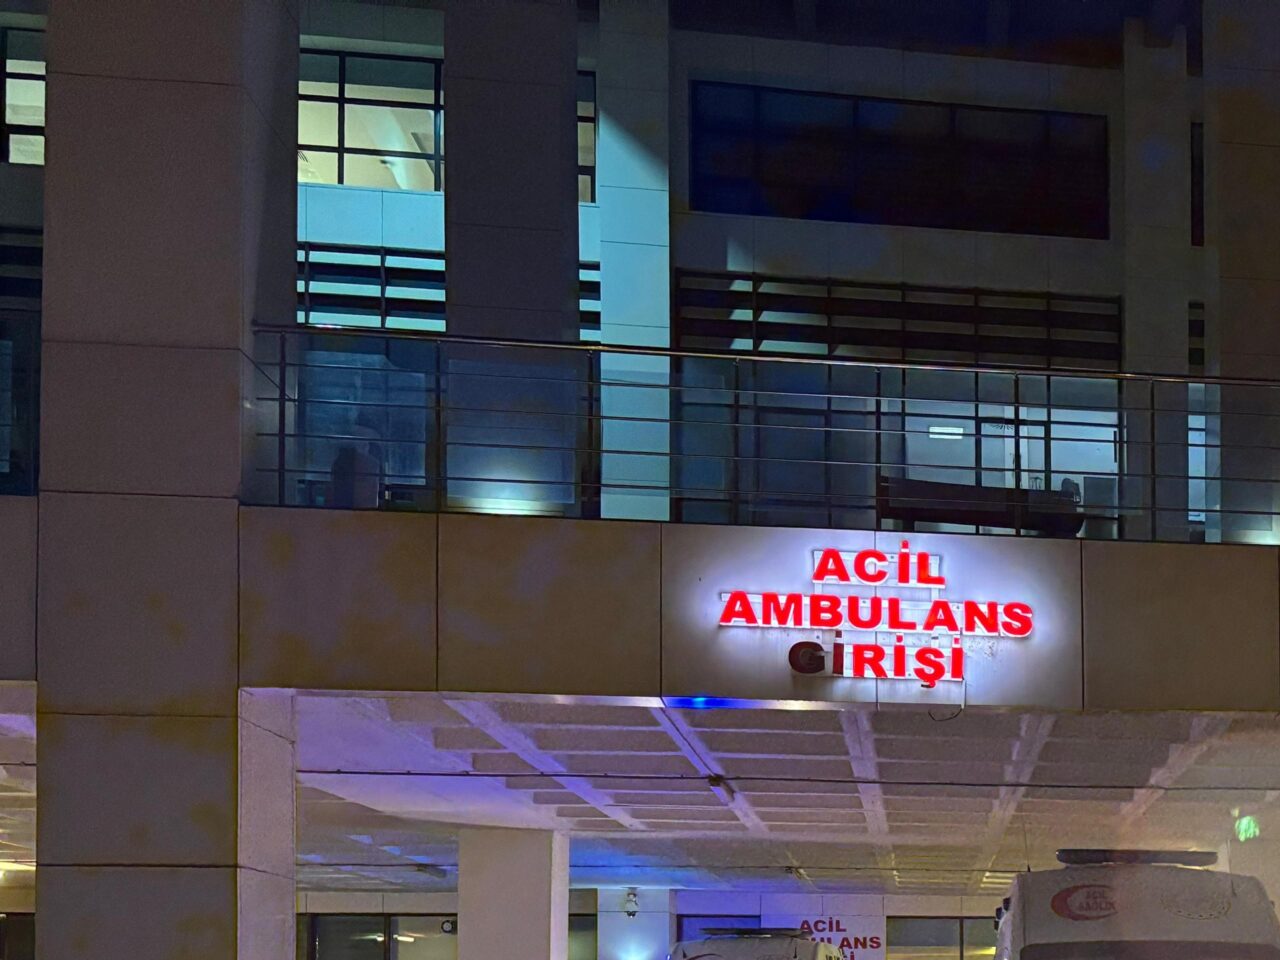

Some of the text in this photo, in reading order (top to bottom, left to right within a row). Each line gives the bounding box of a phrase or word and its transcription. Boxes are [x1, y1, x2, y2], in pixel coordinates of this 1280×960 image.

[812, 539, 945, 586] ACİL
[719, 590, 1034, 638] AMBULANS
[788, 629, 964, 688] GİRİŞİ
[800, 916, 847, 932] ACİL
